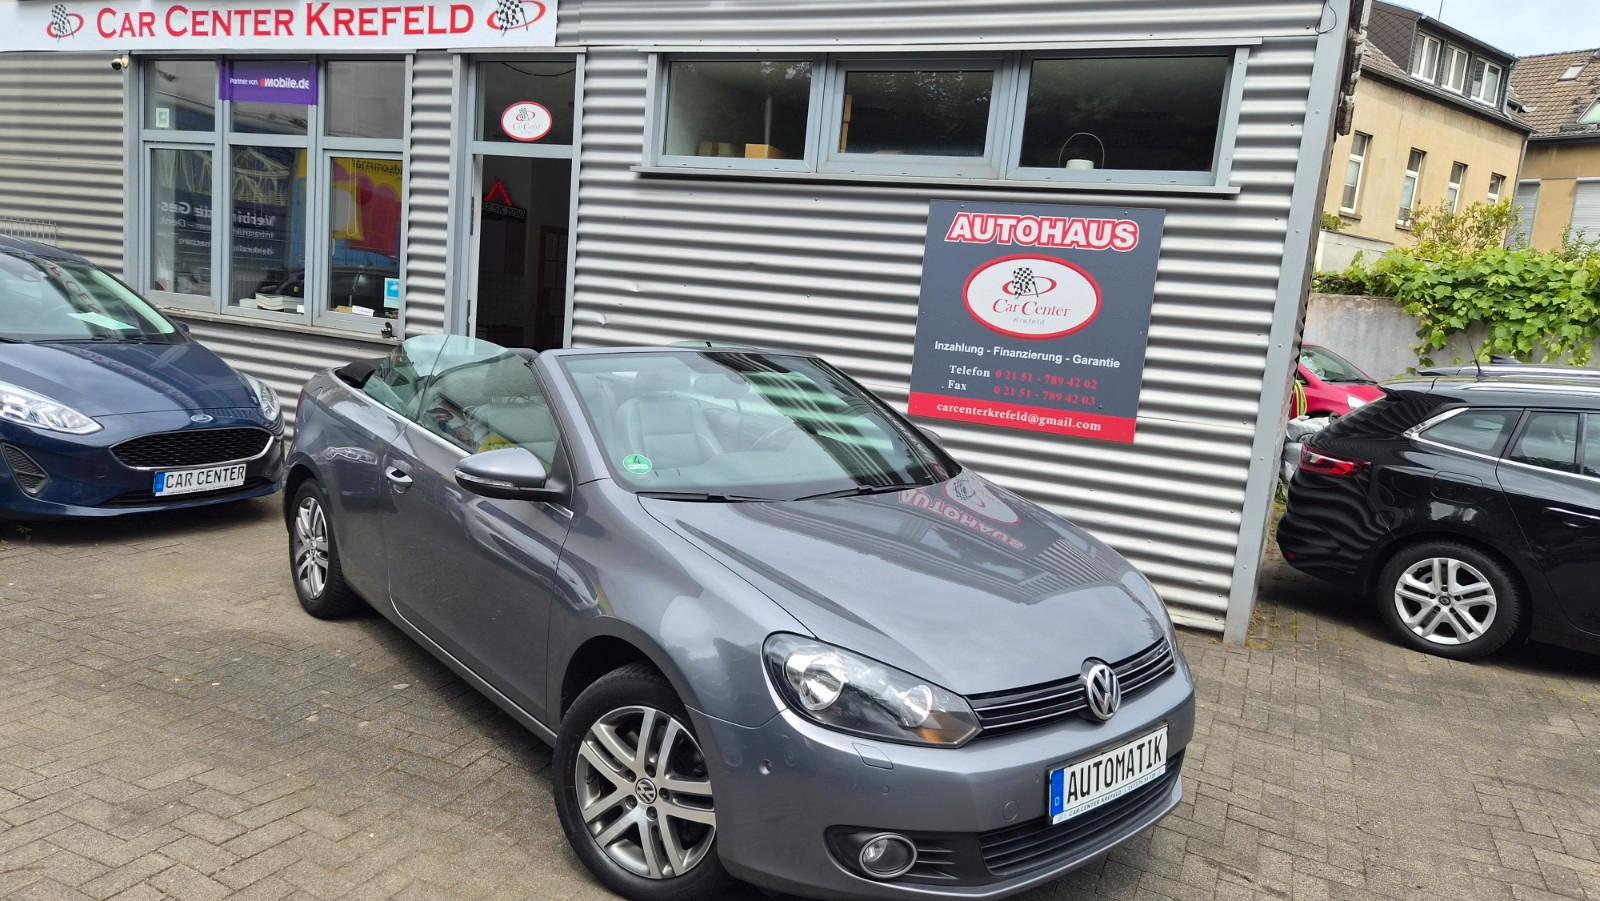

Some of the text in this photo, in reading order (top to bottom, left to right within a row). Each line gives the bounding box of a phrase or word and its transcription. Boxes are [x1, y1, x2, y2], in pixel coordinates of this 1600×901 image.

[97, 1, 474, 39] CAR CENTER KREFELD
[264, 76, 309, 90] mobile.de
[944, 211, 1140, 252] AUTOHAUS
[992, 298, 1071, 318] Car Center
[1013, 316, 1046, 326] Krefeld
[934, 340, 984, 356] Inzahlung
[993, 346, 1063, 364] Finanzierung
[1072, 354, 1120, 369] Garantie
[949, 365, 991, 378] Telefon
[995, 370, 1002, 379] 0
[1005, 370, 1018, 380] 21
[1021, 371, 1033, 383] 51
[1044, 374, 1065, 386] 789
[1067, 377, 1080, 388] 42
[1083, 379, 1098, 390] 02
[947, 379, 967, 391] Fax
[993, 385, 1001, 395] 0
[1004, 385, 1016, 396] 21
[1019, 387, 1031, 398] 51
[1042, 390, 1063, 402] 789
[1065, 393, 1079, 404] 42
[936, 402, 1102, 432] carcenterkrefeld@gmail.com
[166, 466, 245, 488] CAR CENTER
[1066, 733, 1163, 804] AUTOMATIK
